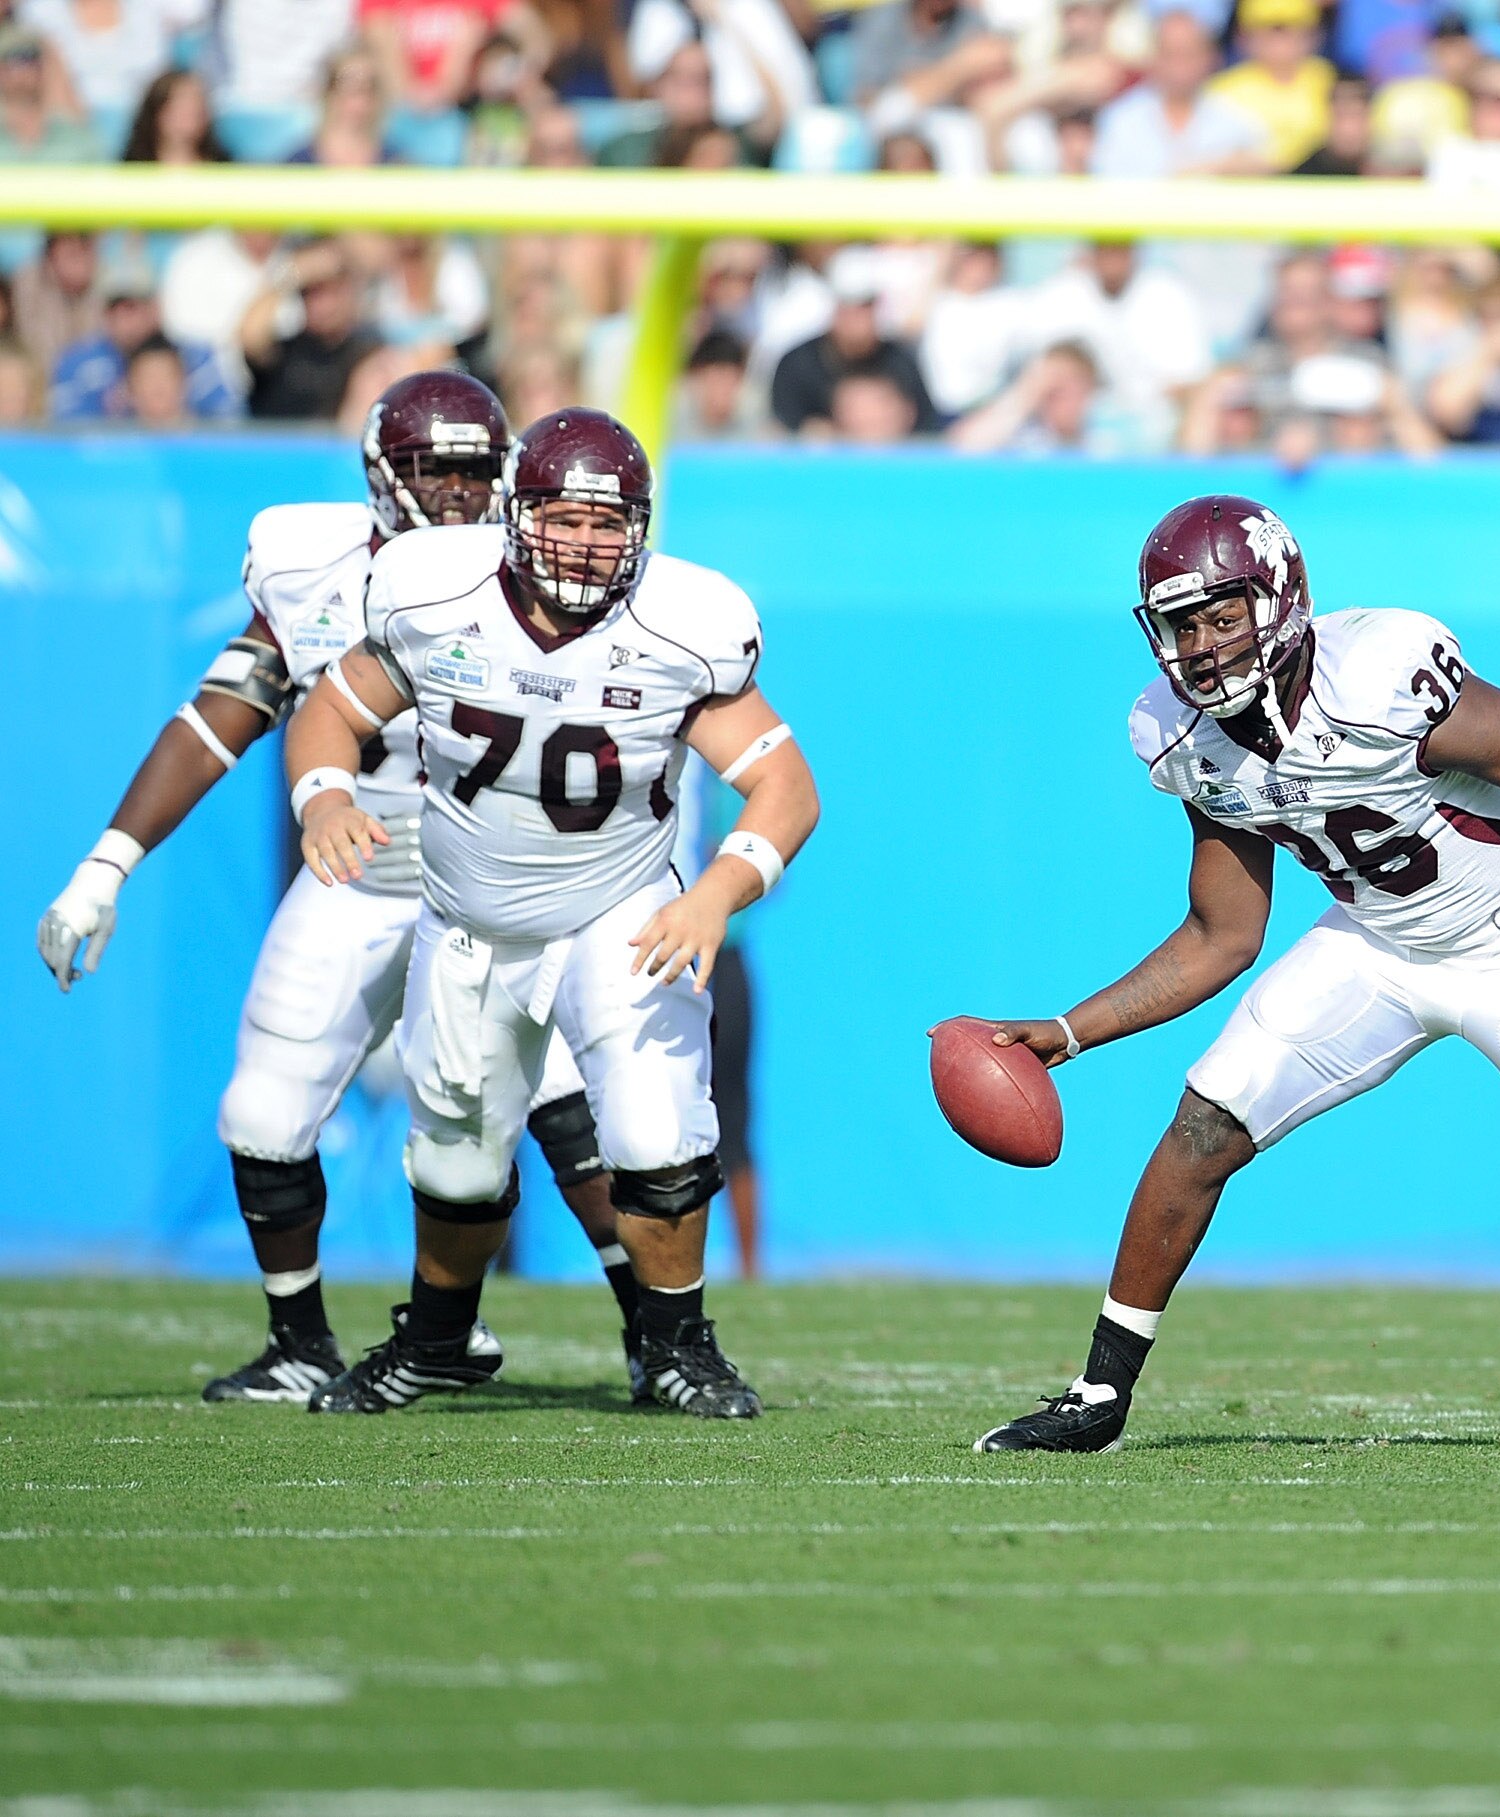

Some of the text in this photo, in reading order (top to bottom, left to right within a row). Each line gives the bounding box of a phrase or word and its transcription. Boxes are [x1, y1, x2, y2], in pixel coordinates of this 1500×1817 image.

[510, 669, 577, 693] MISSISSIPPI
[1410, 641, 1466, 724] 36
[450, 700, 622, 835] 70
[1257, 779, 1313, 799] MISSISSIPPI
[1277, 791, 1308, 808] STATE
[1255, 803, 1440, 905] 36
